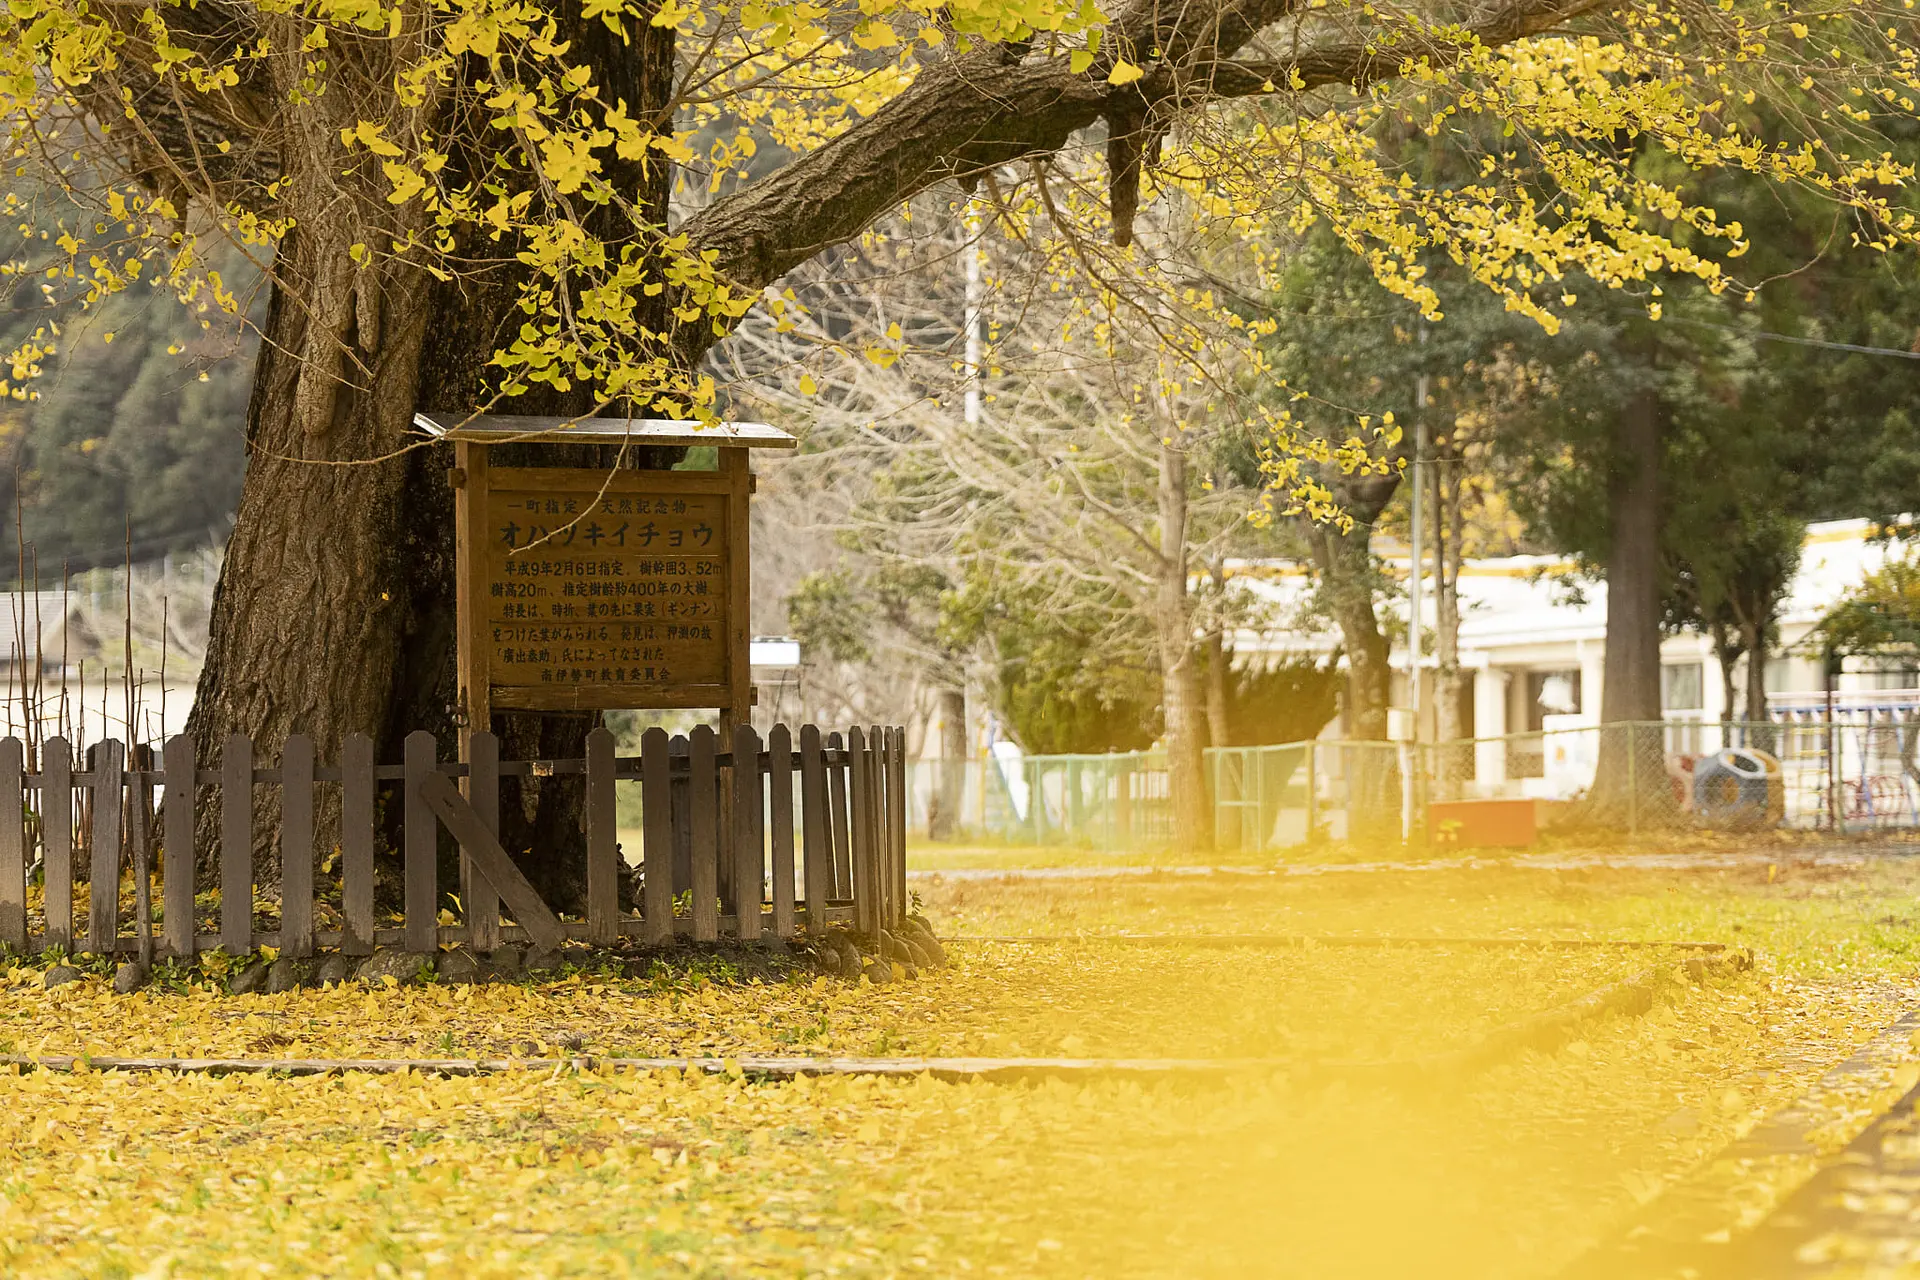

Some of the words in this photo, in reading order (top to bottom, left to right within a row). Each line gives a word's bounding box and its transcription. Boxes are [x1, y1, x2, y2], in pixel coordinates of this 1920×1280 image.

[500, 521, 713, 548] オハツキイチョウ
[541, 667, 671, 682] 南伊勢町教育委員会
